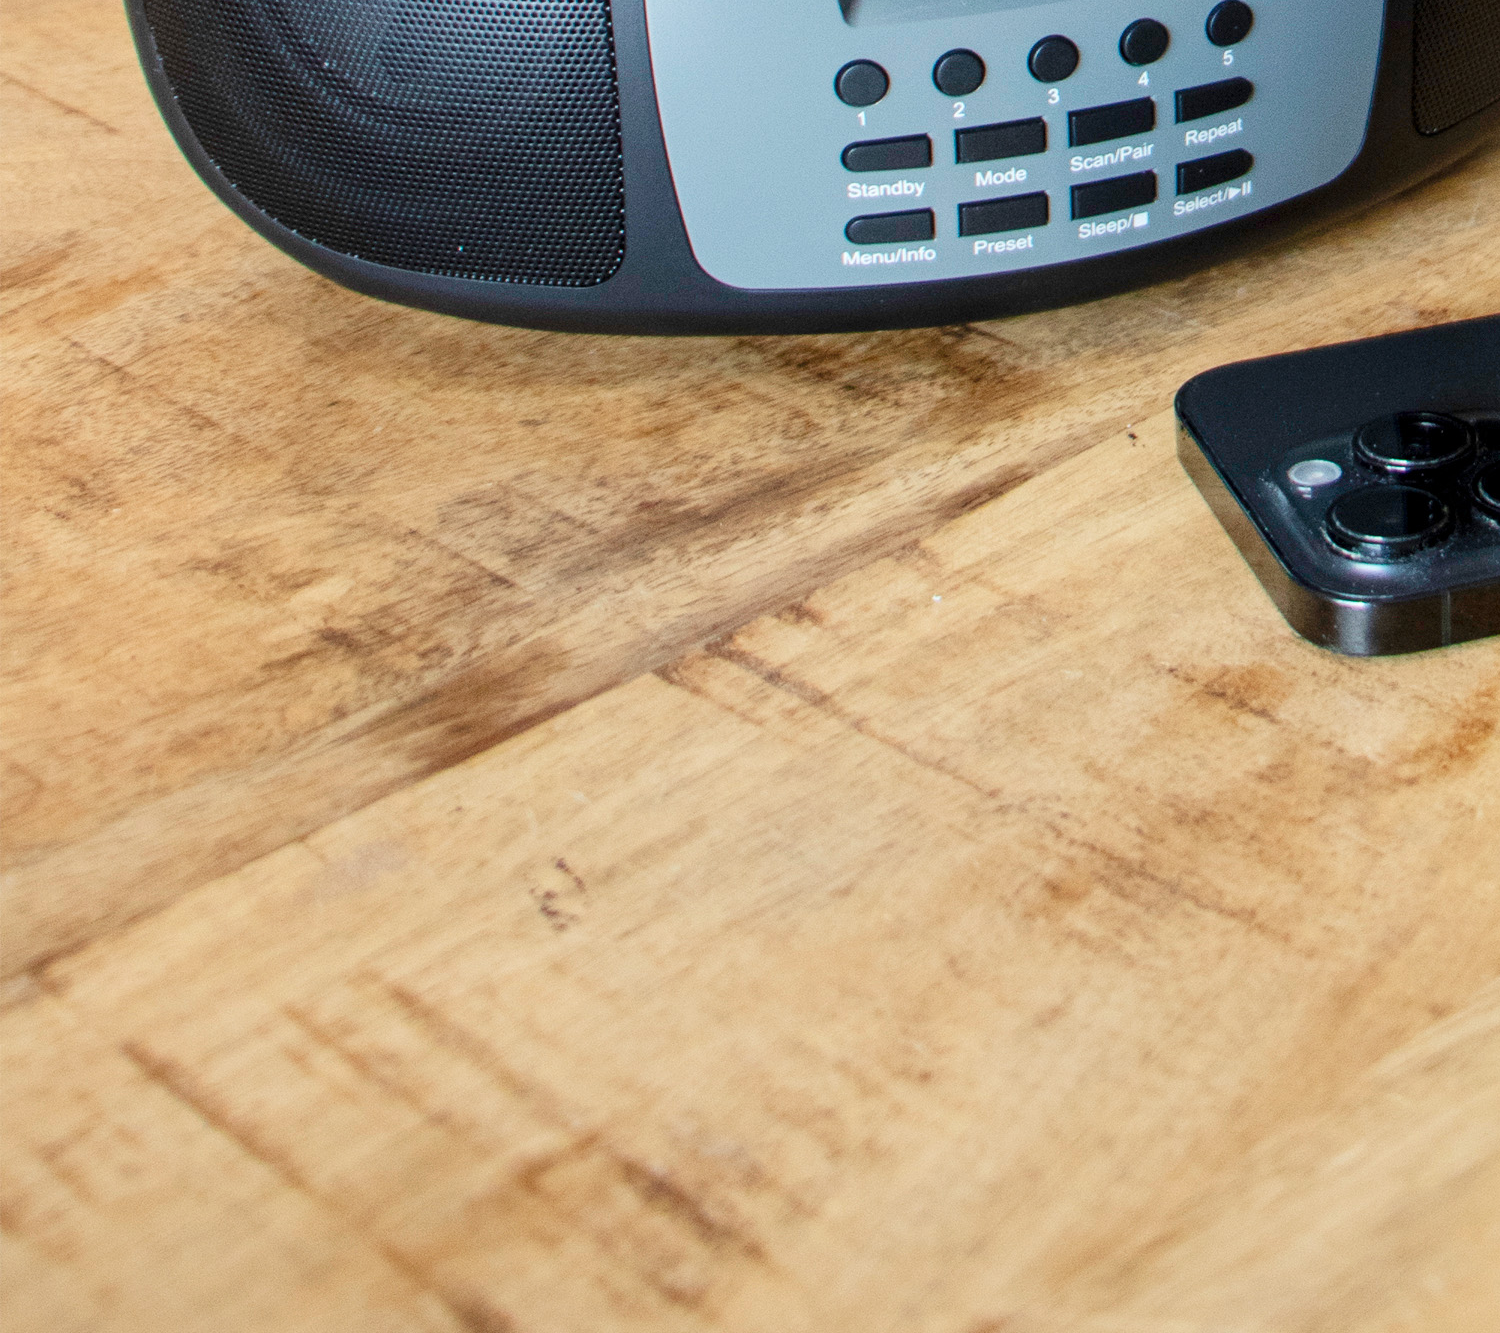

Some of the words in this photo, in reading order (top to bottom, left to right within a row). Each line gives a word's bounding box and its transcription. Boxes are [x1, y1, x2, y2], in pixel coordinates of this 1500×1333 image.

[1222, 48, 1235, 67] 5
[1136, 69, 1151, 87] 4
[1046, 86, 1061, 106] 3
[856, 110, 867, 127] 1
[952, 100, 967, 120] 2
[1184, 117, 1243, 147] Repeat
[1070, 143, 1154, 172] Scan/Pair
[975, 167, 1027, 187] Mode
[847, 179, 925, 199] Standby
[973, 234, 1034, 255] Preset
[842, 246, 937, 266] Menu/Info
